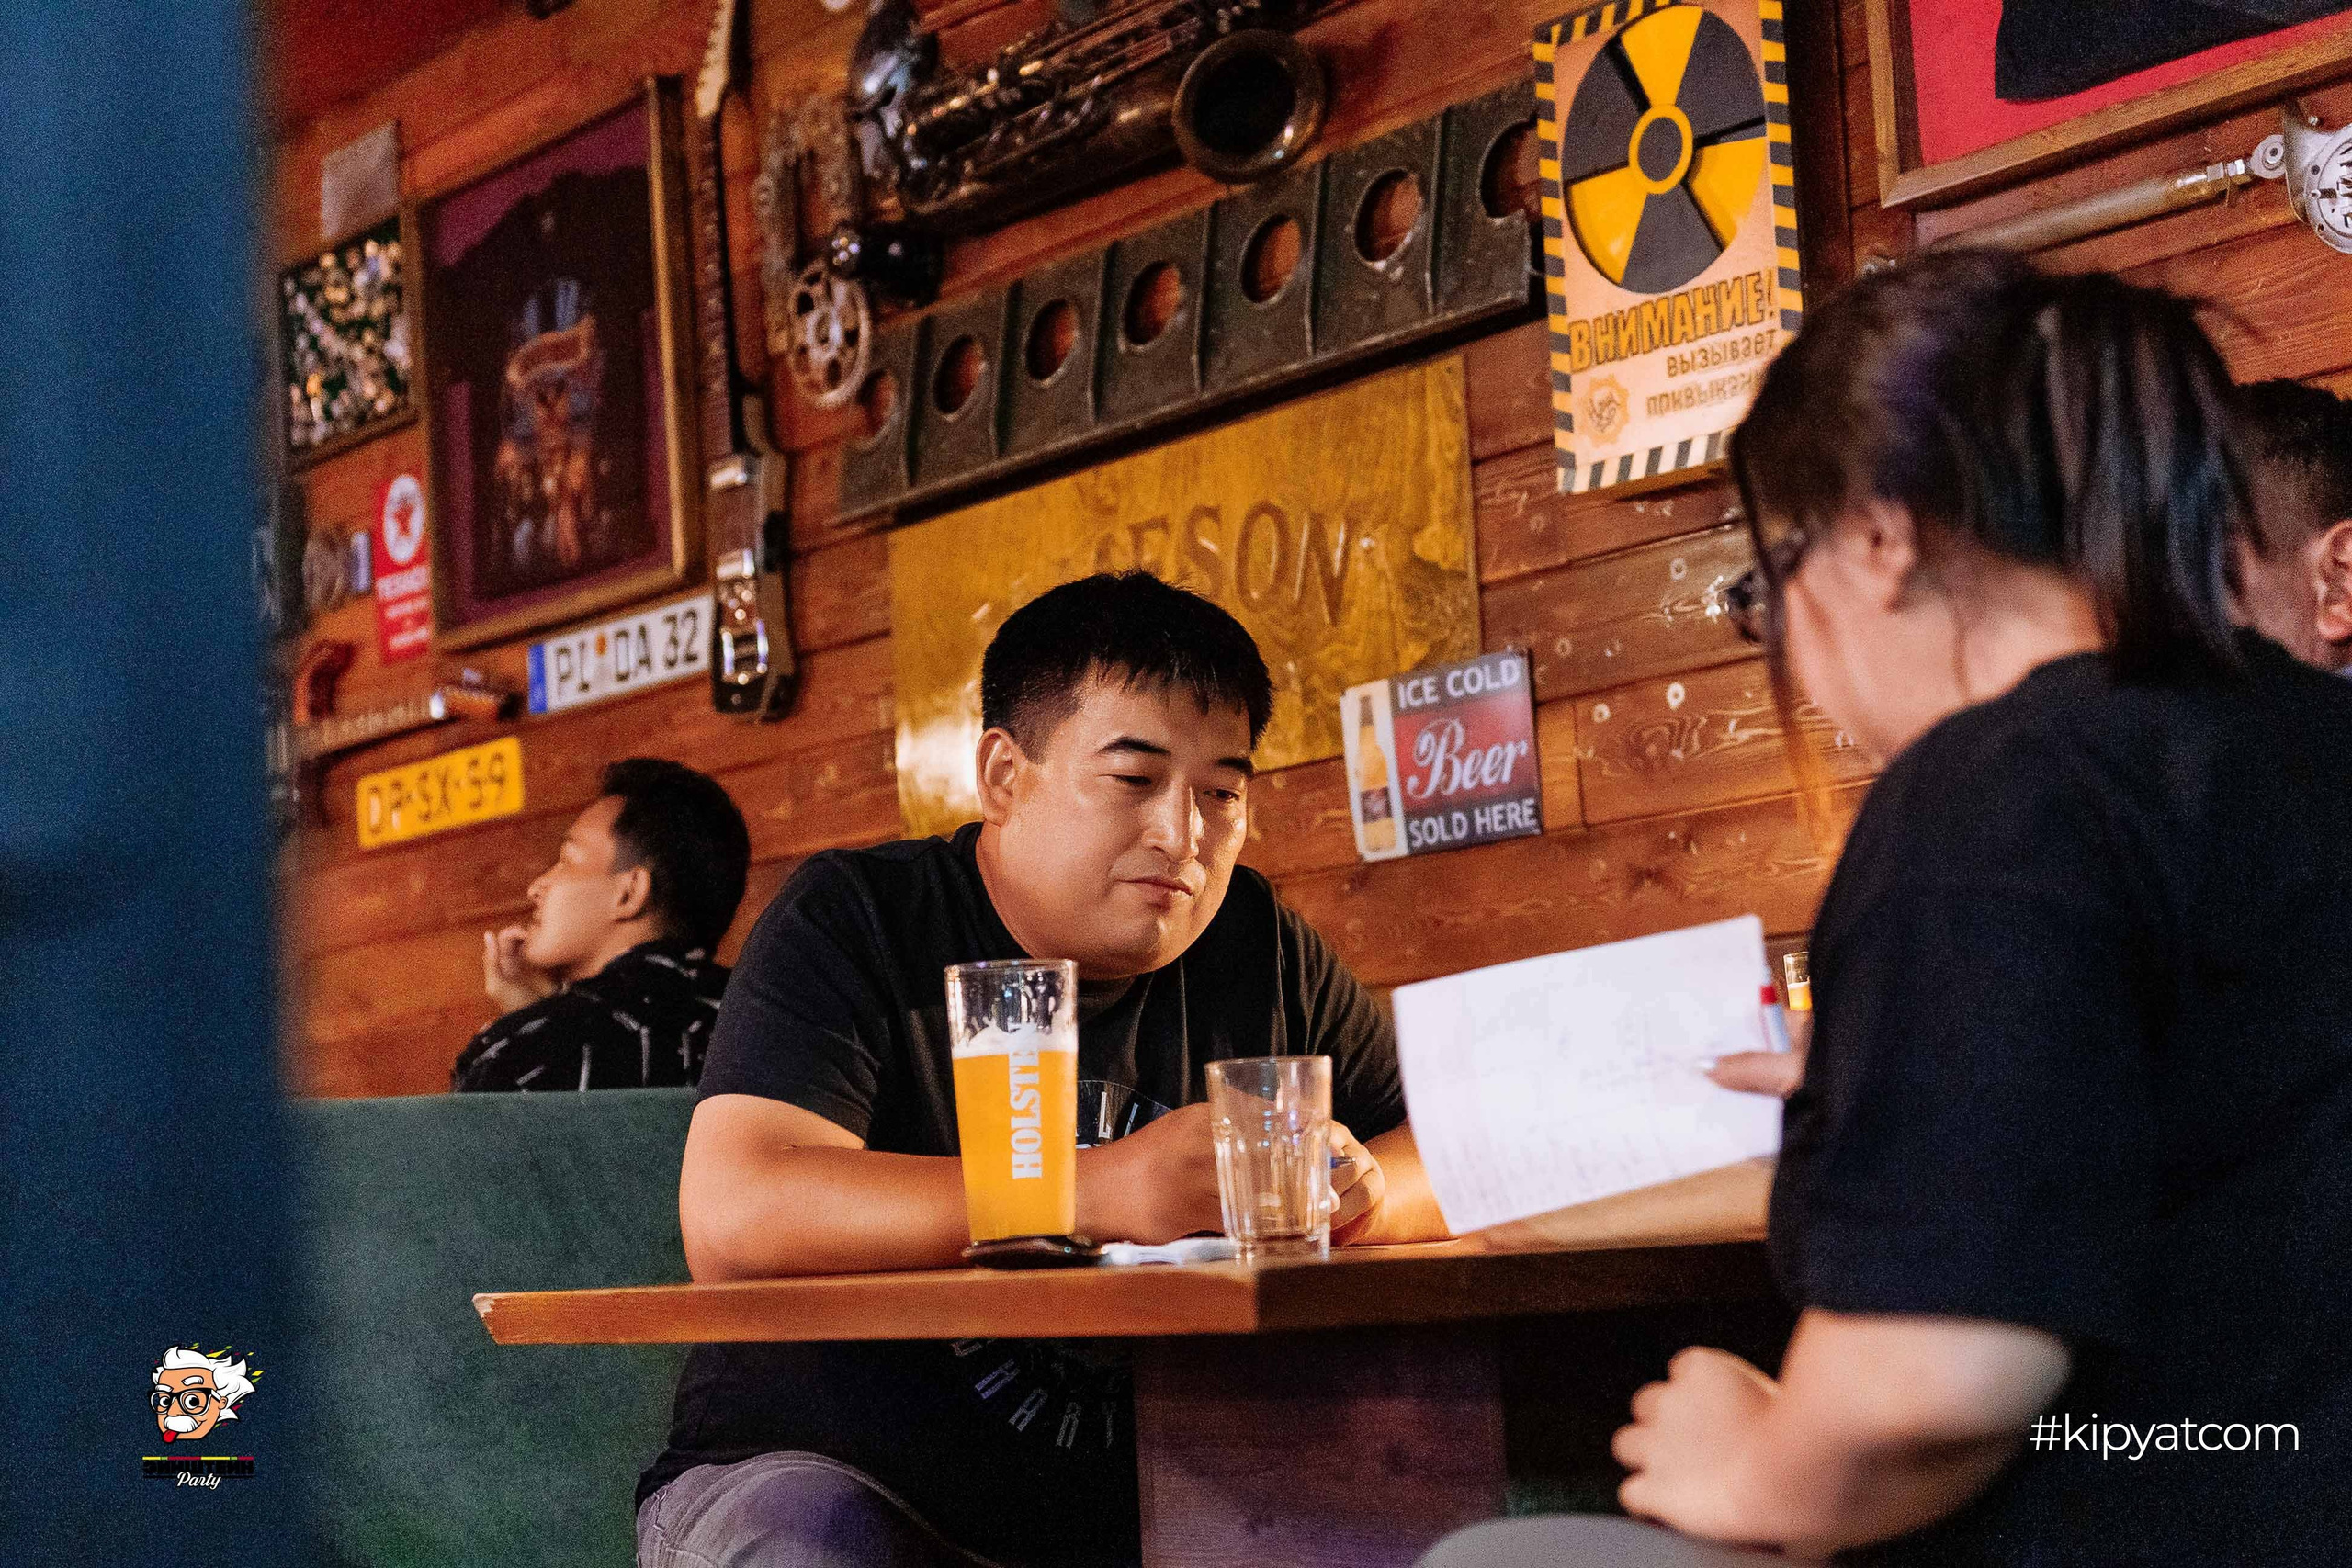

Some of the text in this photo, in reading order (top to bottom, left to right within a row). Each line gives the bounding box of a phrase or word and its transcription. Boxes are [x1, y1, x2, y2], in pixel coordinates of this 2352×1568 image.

[1567, 269, 1776, 375] ВНИМАНИЕ!
[1667, 329, 1778, 378] вызывает
[614, 623, 652, 682] DA
[662, 607, 699, 670] 32
[1397, 657, 1521, 710] ICE COLD
[1407, 716, 1529, 800] Beer
[1408, 797, 1537, 849] SOLD HERE
